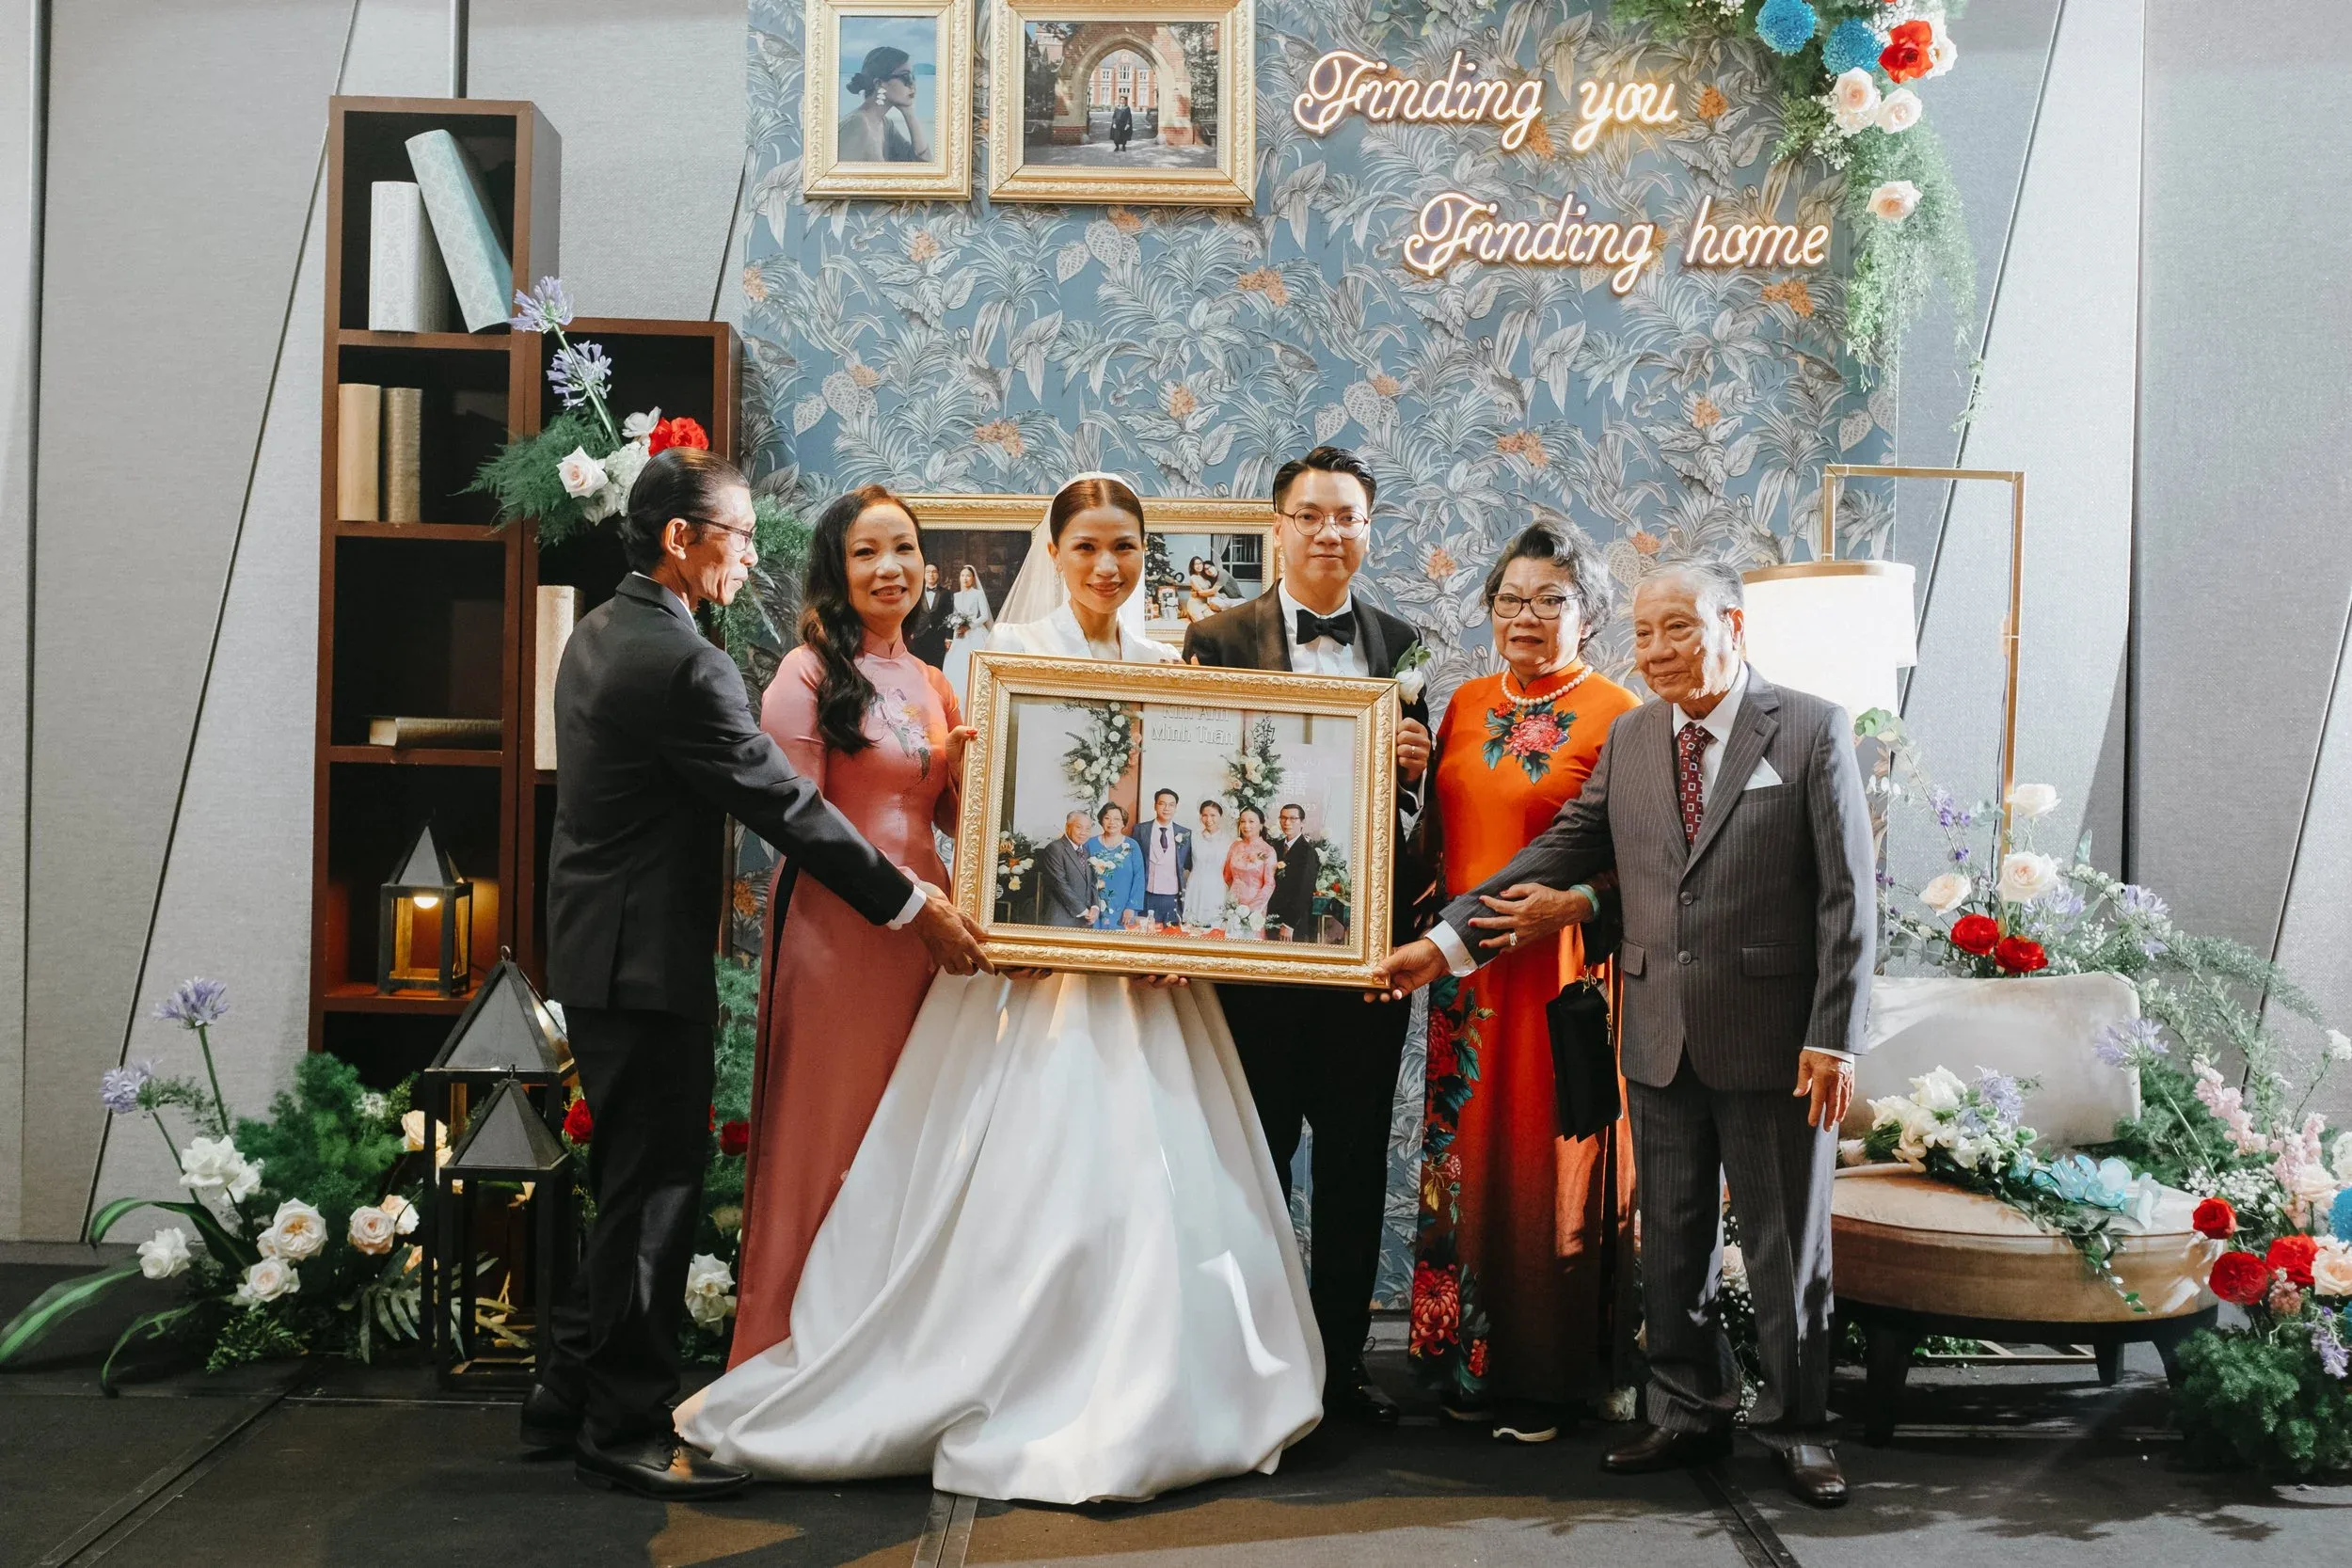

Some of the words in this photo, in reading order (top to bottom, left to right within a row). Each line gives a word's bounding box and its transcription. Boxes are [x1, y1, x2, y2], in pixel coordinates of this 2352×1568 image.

[1292, 49, 1545, 152] Finding
[1569, 76, 1679, 153] you
[1403, 190, 1655, 294] Finding
[1684, 194, 1832, 267] home
[1152, 722, 1192, 743] Minh
